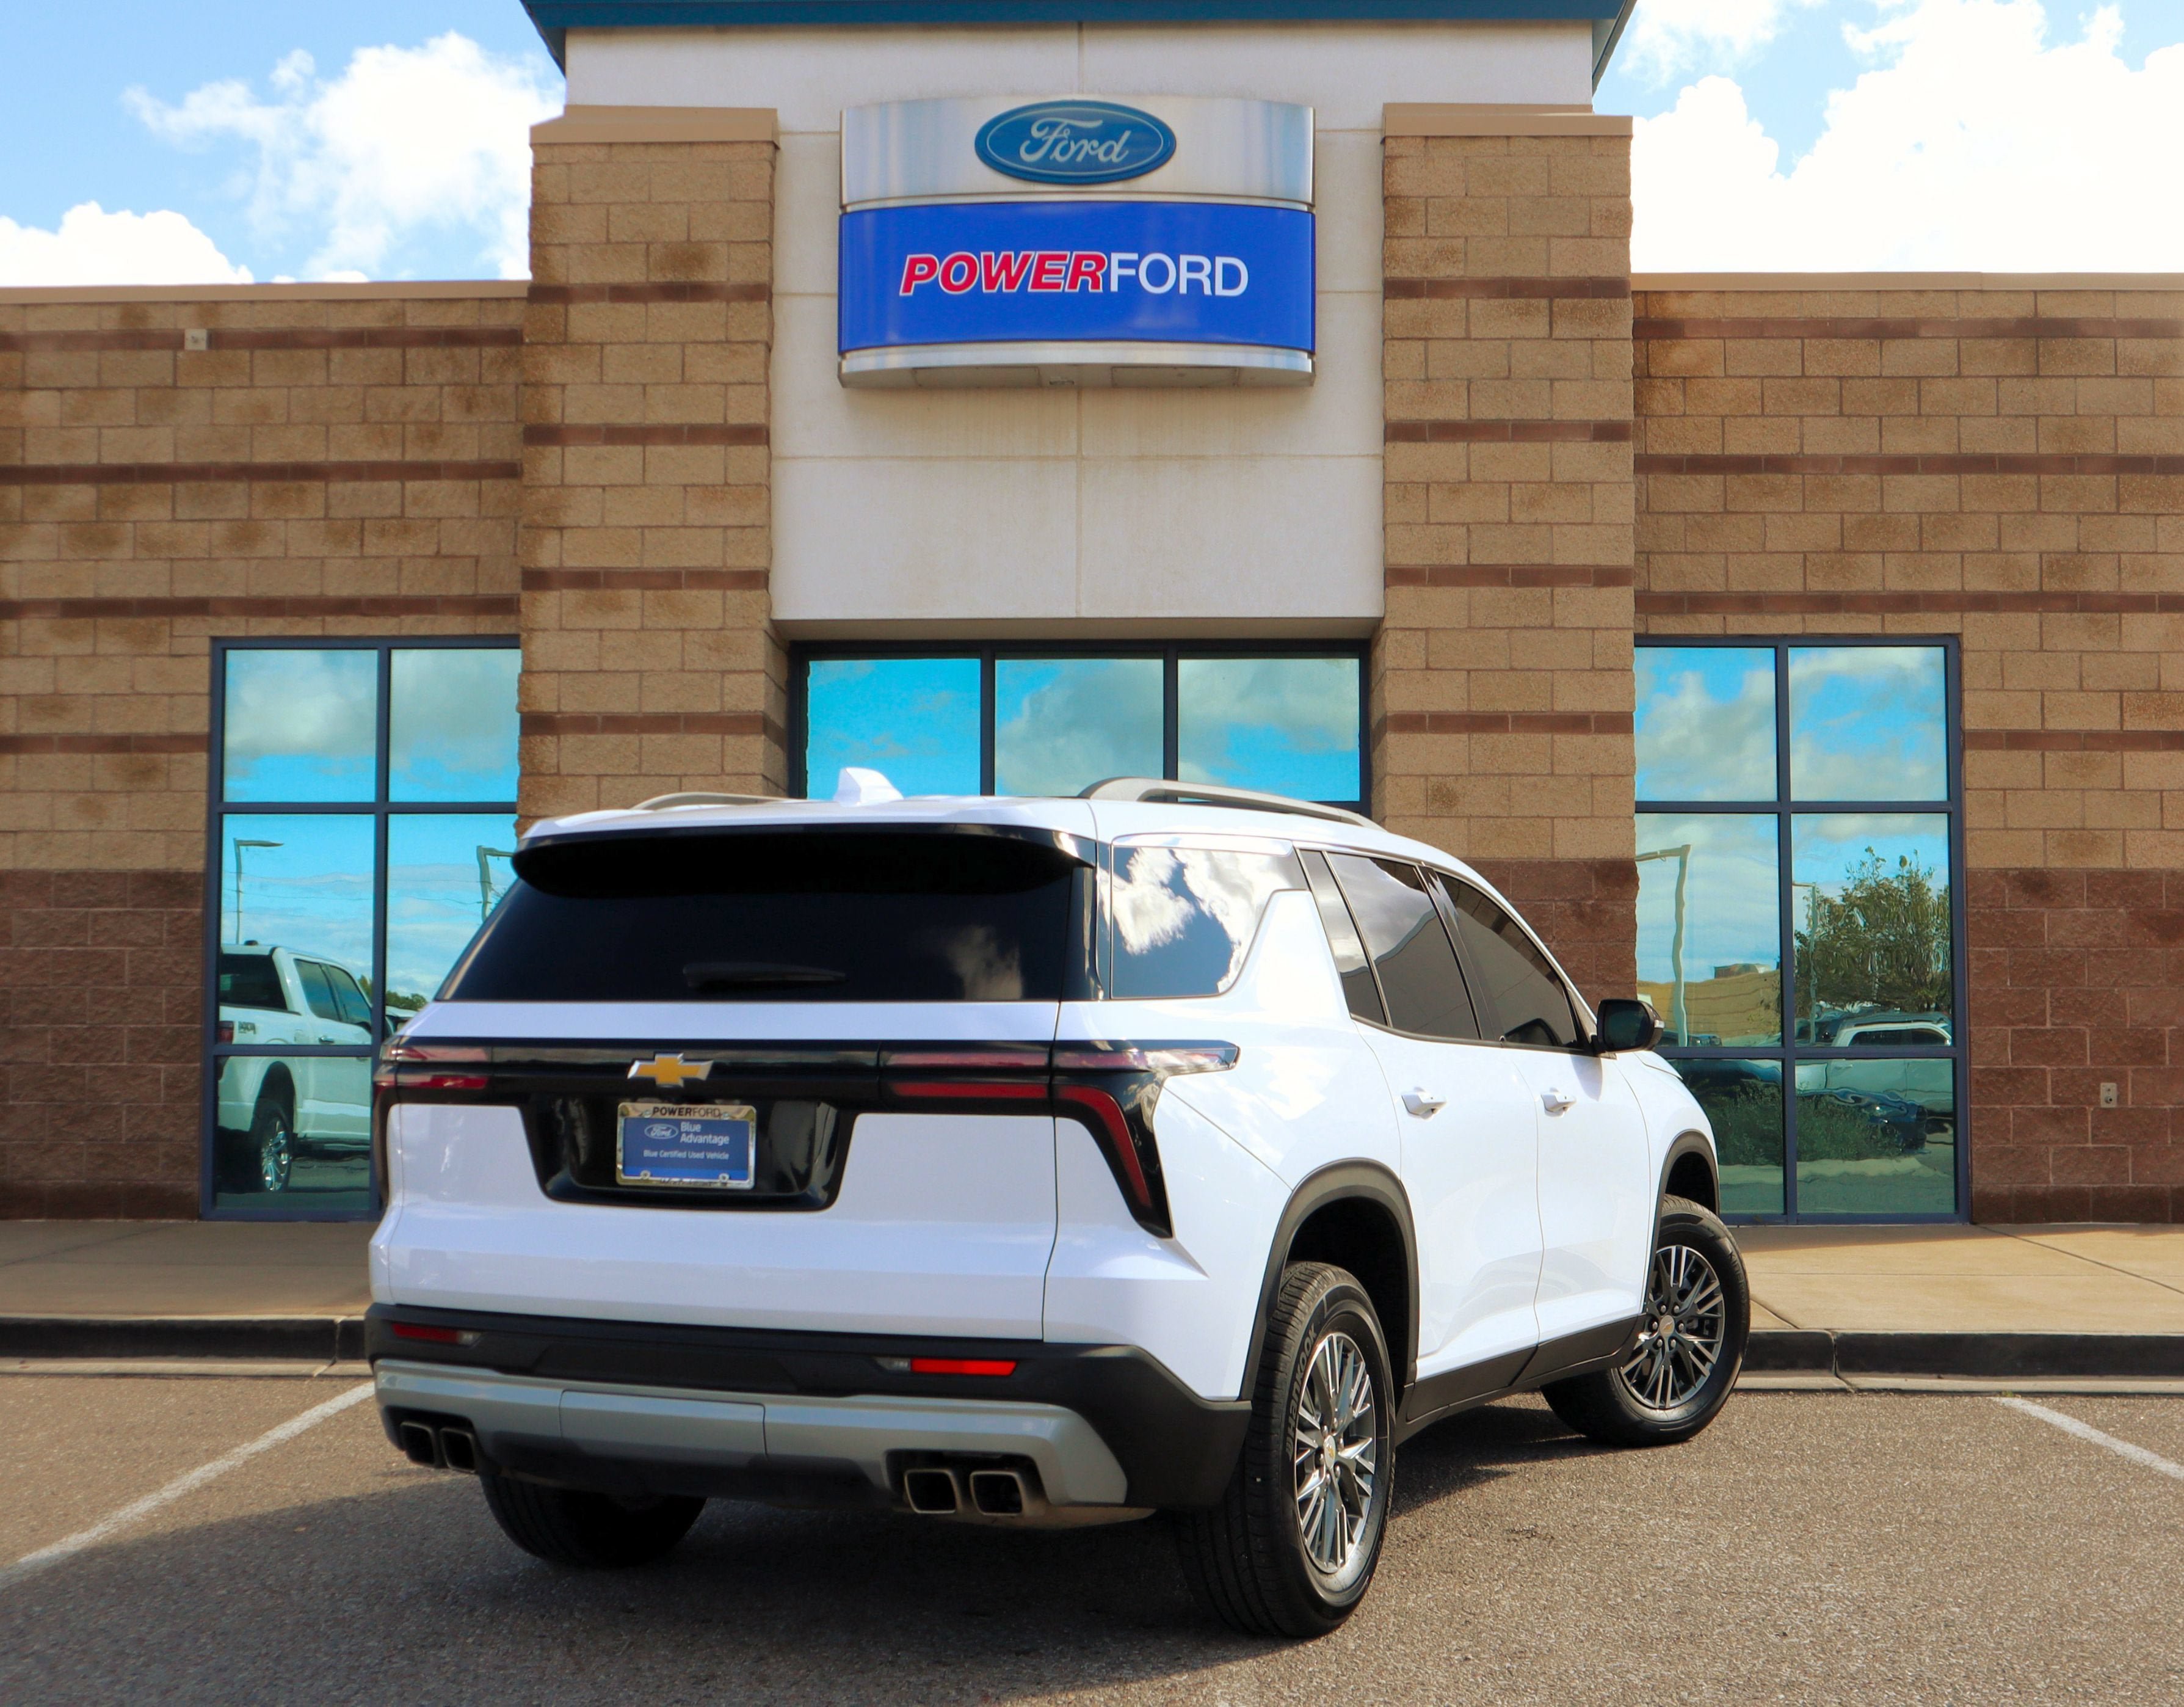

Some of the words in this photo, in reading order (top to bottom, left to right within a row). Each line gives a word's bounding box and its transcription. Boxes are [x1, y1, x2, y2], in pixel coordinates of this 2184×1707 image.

[1020, 117, 1131, 163] Ford
[899, 251, 1249, 298] POWERFORD
[652, 1106, 722, 1118] POWERFORD
[650, 1126, 672, 1137] Ford
[680, 1121, 702, 1132] Blue
[680, 1133, 730, 1146] Advantage
[659, 1149, 686, 1159] Certified
[688, 1151, 705, 1159] Used
[706, 1151, 730, 1160] Vehicle
